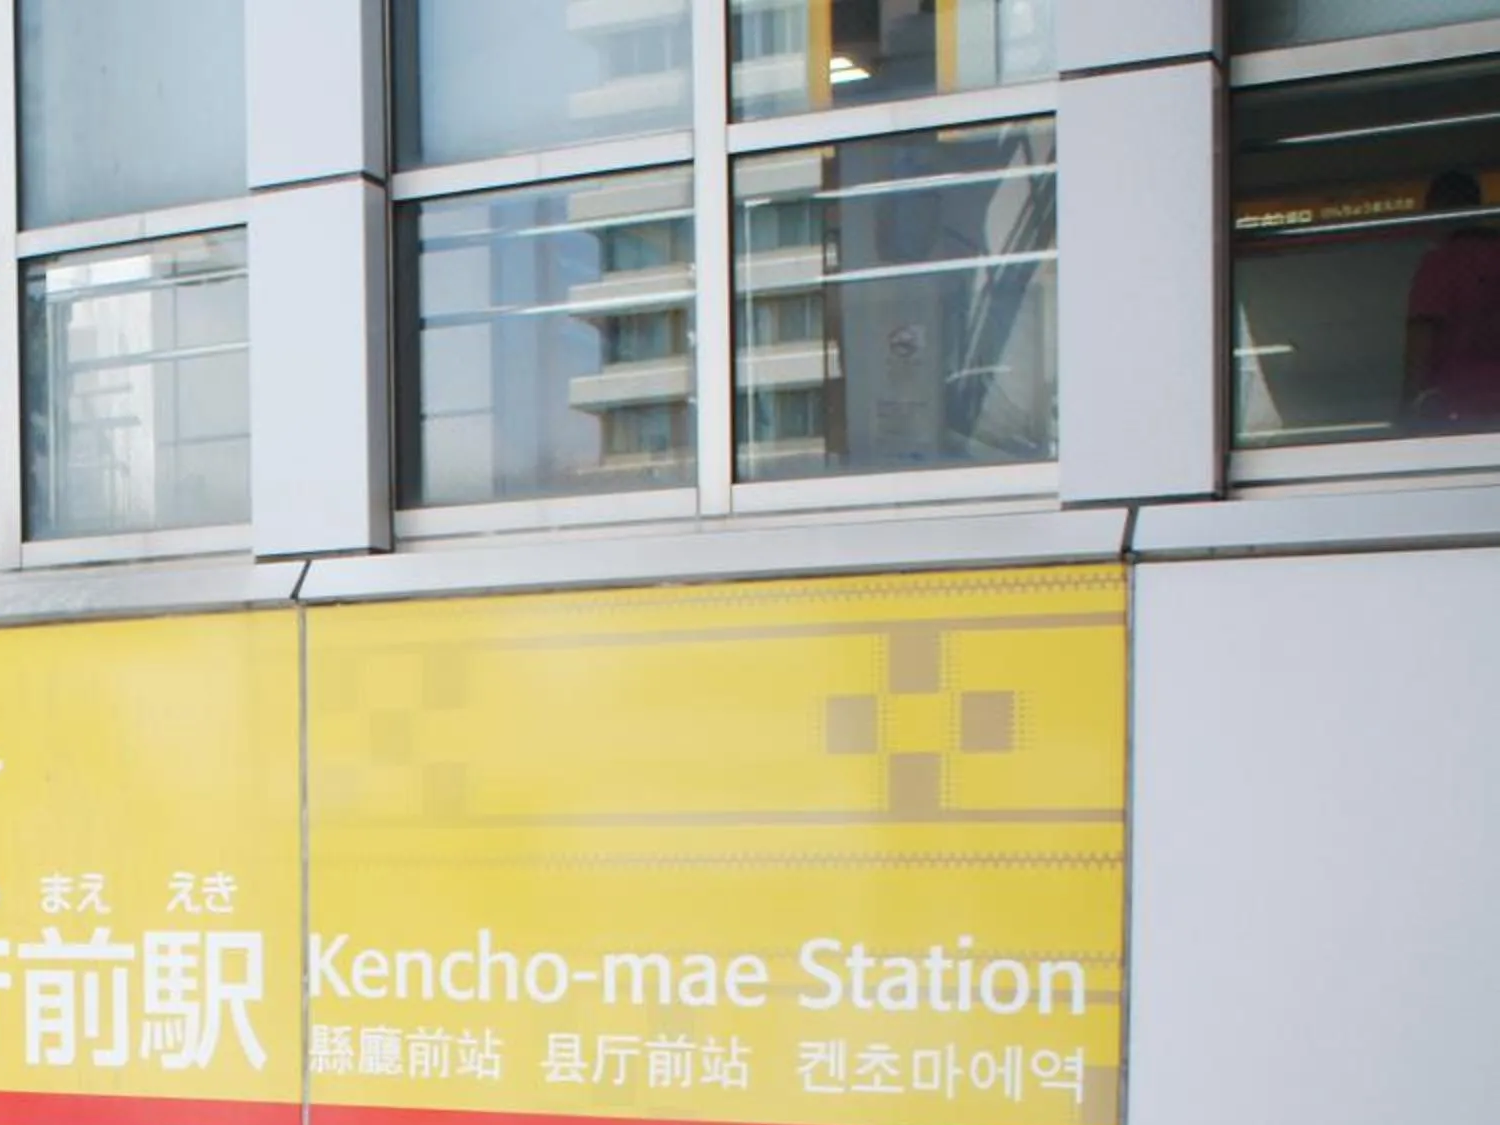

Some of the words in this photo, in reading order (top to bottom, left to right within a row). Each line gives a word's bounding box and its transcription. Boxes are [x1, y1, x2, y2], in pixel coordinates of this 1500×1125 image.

[39, 872, 112, 915] まえ
[167, 871, 239, 914] えき
[307, 927, 769, 1008] Kencho-mae
[799, 934, 1087, 1015] Station
[308, 1023, 505, 1080] 縣廳前站
[540, 1032, 754, 1089] 县厅前站
[797, 1038, 1085, 1104] 켄초마에역
